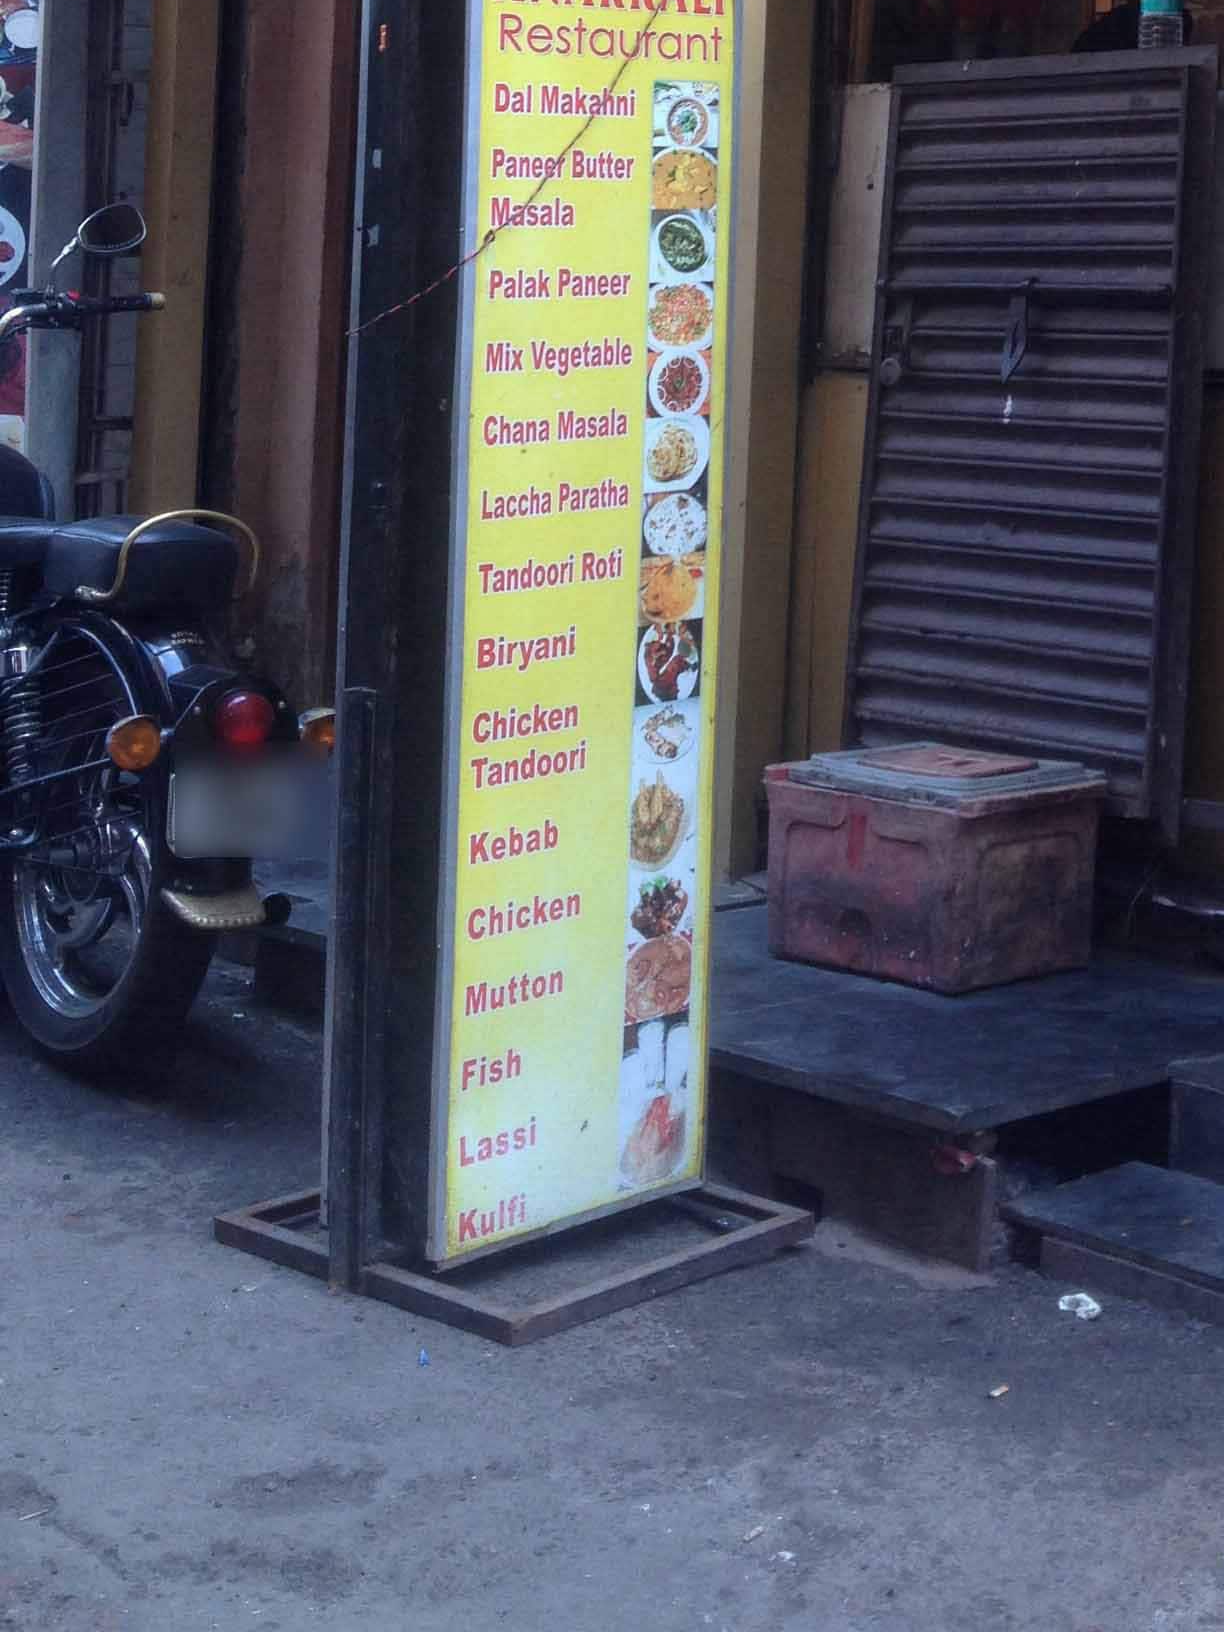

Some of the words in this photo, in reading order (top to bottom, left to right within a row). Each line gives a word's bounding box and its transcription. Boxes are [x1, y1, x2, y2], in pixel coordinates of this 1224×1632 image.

[499, 13, 723, 62] Restaurant
[494, 83, 532, 113] Dal
[541, 86, 636, 117] Makahni
[492, 149, 566, 178] Paneer
[571, 150, 634, 179] Butter
[490, 197, 575, 227] Masala
[489, 270, 550, 299] Palak
[557, 268, 631, 297] Paneer
[486, 343, 522, 371] Mix
[531, 338, 632, 376] Vegetable
[483, 415, 550, 446] Chana
[557, 409, 628, 440] Masala
[481, 486, 551, 519] Laccha
[558, 480, 629, 512] Paratha
[479, 554, 575, 594] Tandoori
[581, 549, 623, 579] Roti
[477, 626, 576, 670] Biryani
[473, 704, 578, 743] Chicken
[471, 740, 586, 789] Tandoori
[469, 820, 559, 864] Kebab
[468, 891, 581, 940] Chicken
[465, 970, 563, 1016] Mutton
[461, 1049, 521, 1091] Fish
[459, 1118, 537, 1167] Lassi
[458, 1193, 526, 1242] Kulfi
